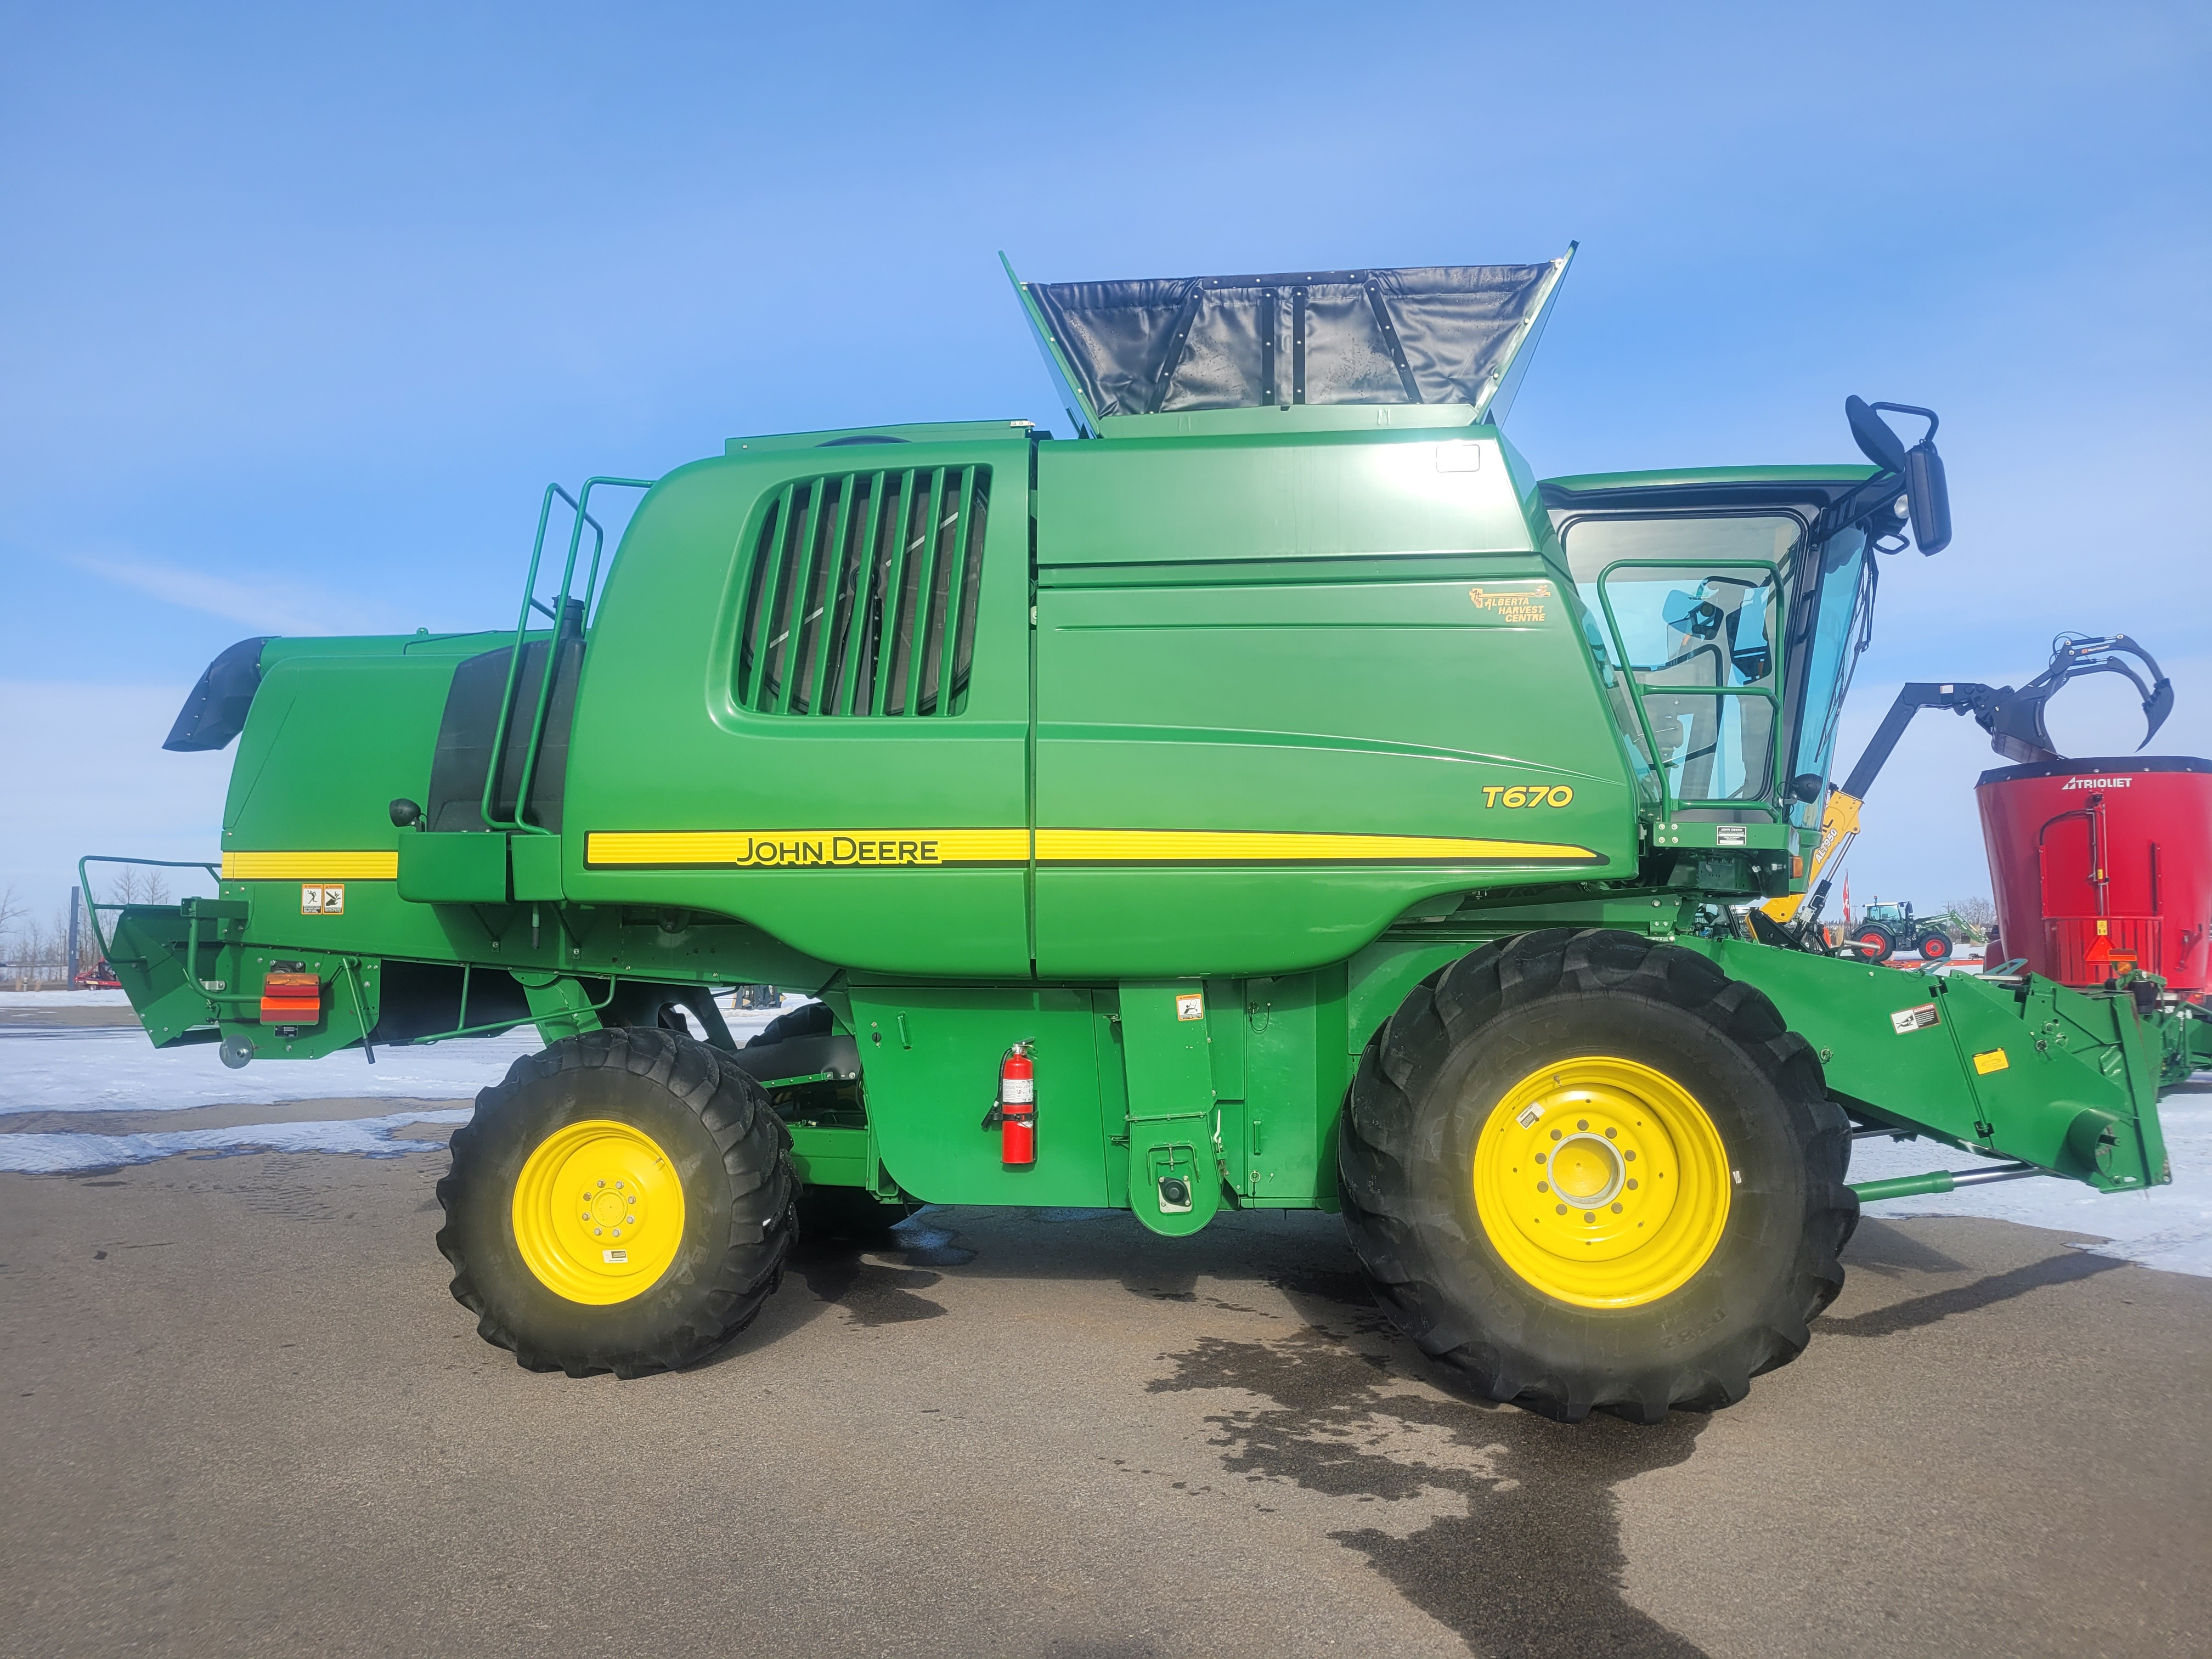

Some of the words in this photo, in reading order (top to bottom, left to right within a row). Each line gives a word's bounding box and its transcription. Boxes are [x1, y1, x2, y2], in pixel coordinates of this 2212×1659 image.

[1485, 597, 1530, 610] ALBERTA
[1498, 606, 1544, 614] HARVEST
[1505, 613, 1545, 622] CENTRE
[2075, 778, 2132, 789] TRIOLIET
[1482, 785, 1573, 808] T670
[736, 837, 824, 864] JOHN
[832, 837, 940, 863] DEERE
[1815, 828, 1838, 864] ALT950
